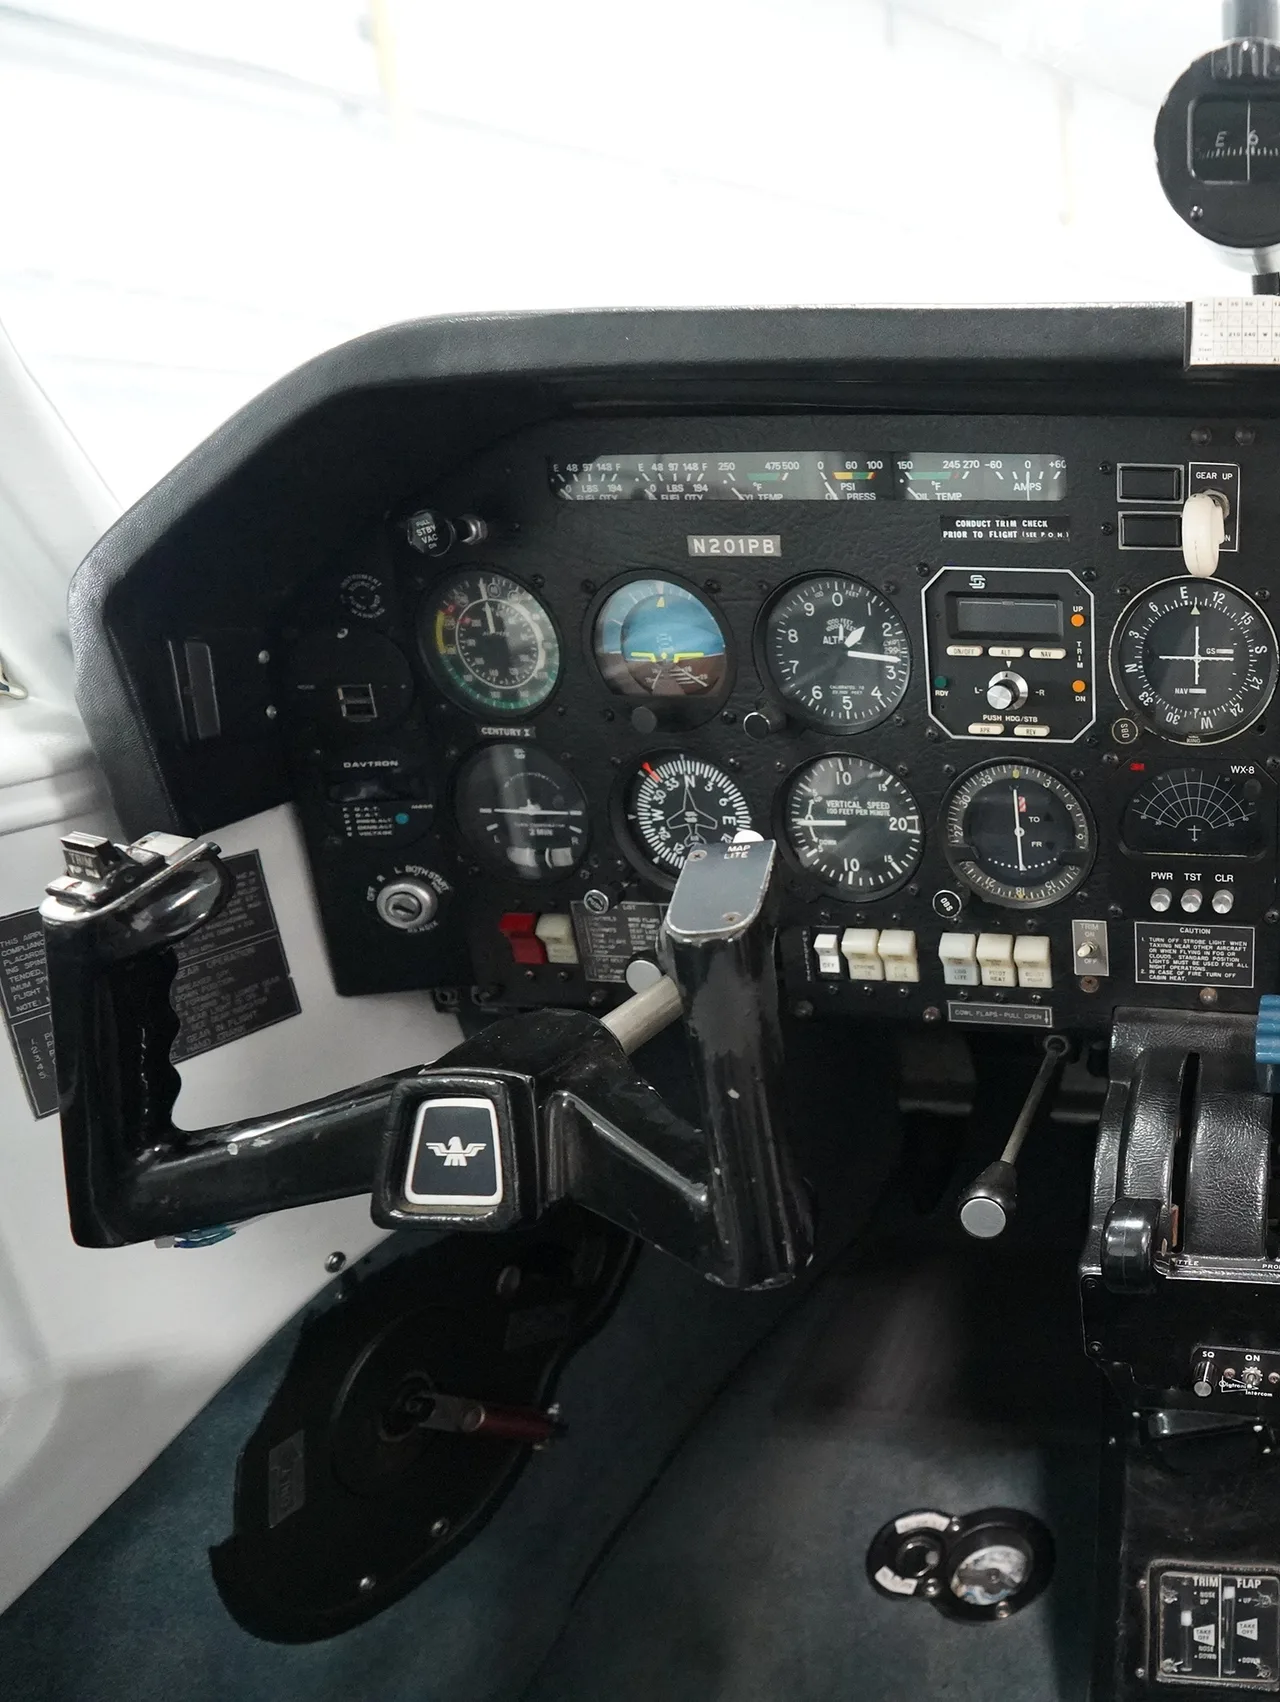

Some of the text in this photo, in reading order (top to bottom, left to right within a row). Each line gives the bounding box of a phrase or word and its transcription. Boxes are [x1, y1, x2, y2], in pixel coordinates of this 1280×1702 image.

[718, 462, 800, 471] 250 500
[867, 461, 883, 469] 100
[897, 460, 980, 469] 150 245 270
[1196, 472, 1232, 480] GEAR UP
[841, 483, 855, 491] PSI
[1014, 482, 1042, 491] AMPS
[416, 525, 436, 536] STBY
[421, 534, 438, 544] VAC
[693, 539, 774, 554] N201PB
[832, 592, 843, 606] 0
[804, 603, 892, 636] 9 2
[788, 629, 798, 643] 8
[789, 660, 896, 680] 7 3
[812, 686, 882, 709] 6 5 4
[482, 727, 520, 736] CENTURY
[1231, 765, 1255, 774] WX-8
[826, 800, 862, 809] VERTICAL
[889, 817, 907, 831] 20
[728, 844, 750, 852] MAP
[1184, 873, 1201, 882] TST
[1215, 874, 1234, 883] CLR
[9, 968, 44, 983] TENDED,
[14, 988, 41, 1001] FLIGHT
[1193, 1577, 1218, 1587] TRIM
[1237, 1578, 1261, 1588] FLAP
